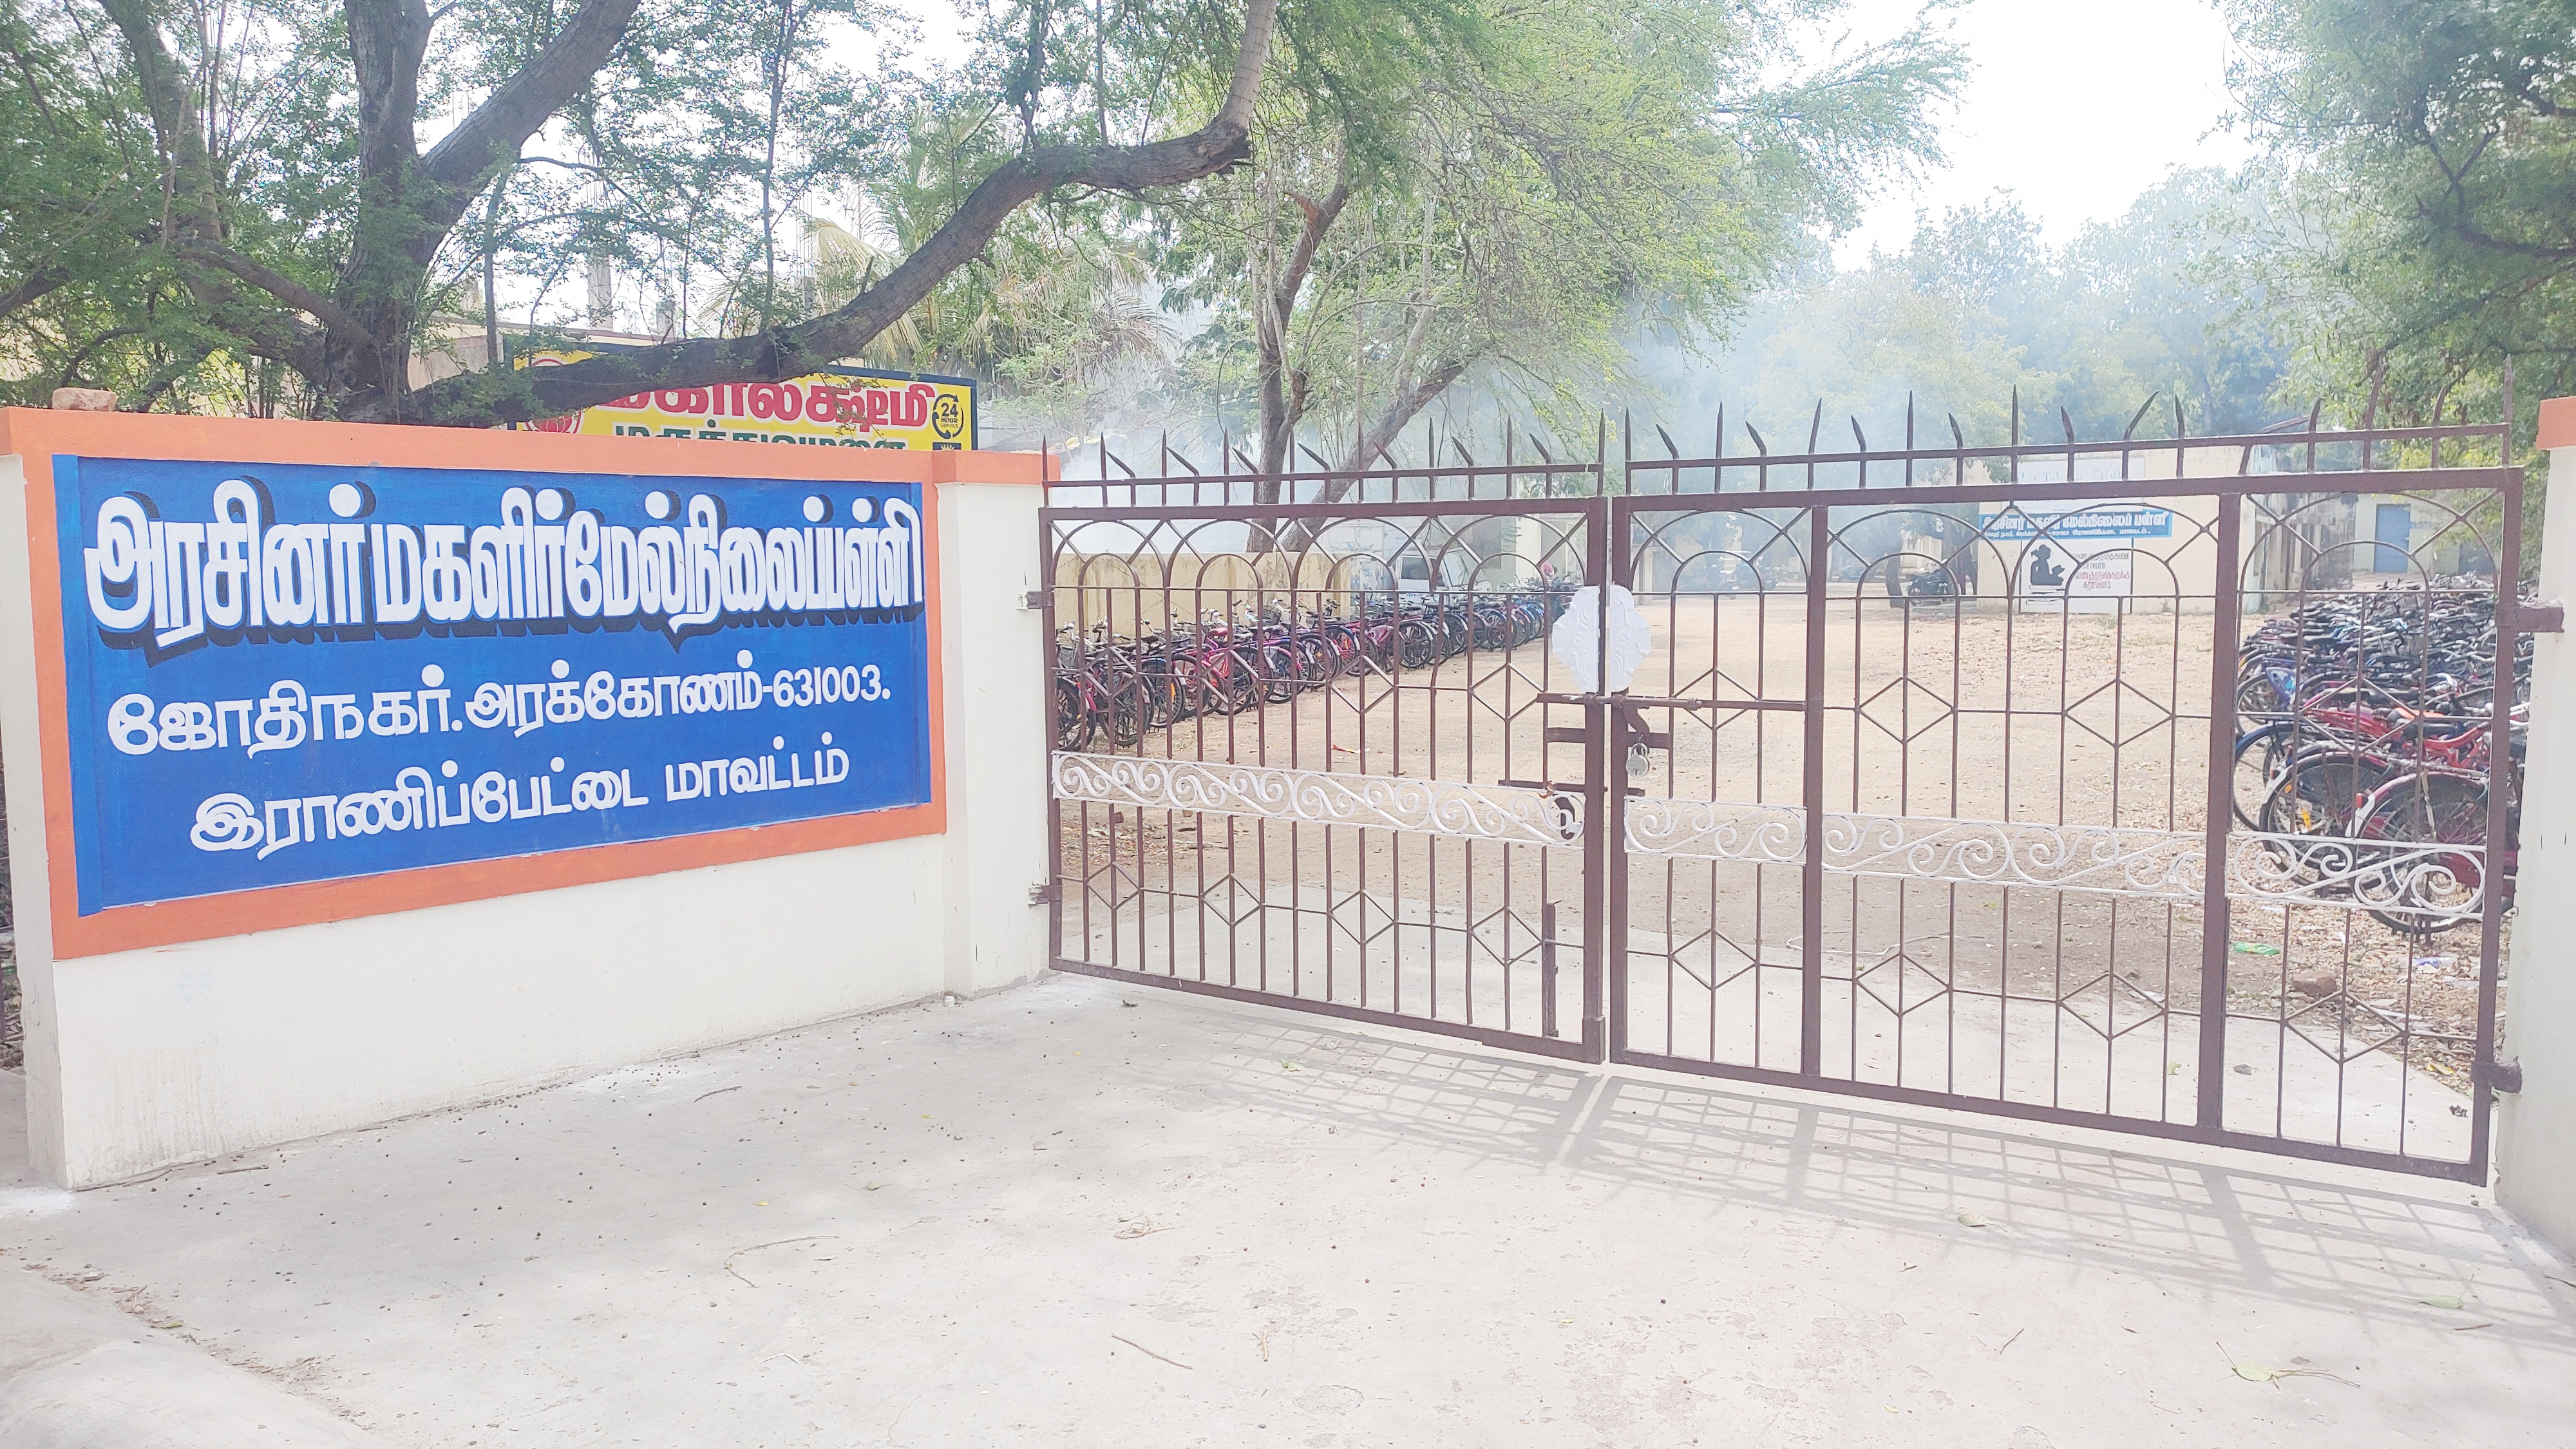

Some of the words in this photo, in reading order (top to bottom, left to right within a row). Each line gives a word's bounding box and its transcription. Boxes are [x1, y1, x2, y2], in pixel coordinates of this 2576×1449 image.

[941, 402, 958, 417] 24
[191, 756, 649, 860] இராணிப்பேட்டை
[665, 731, 849, 802] மாவட்டம்
